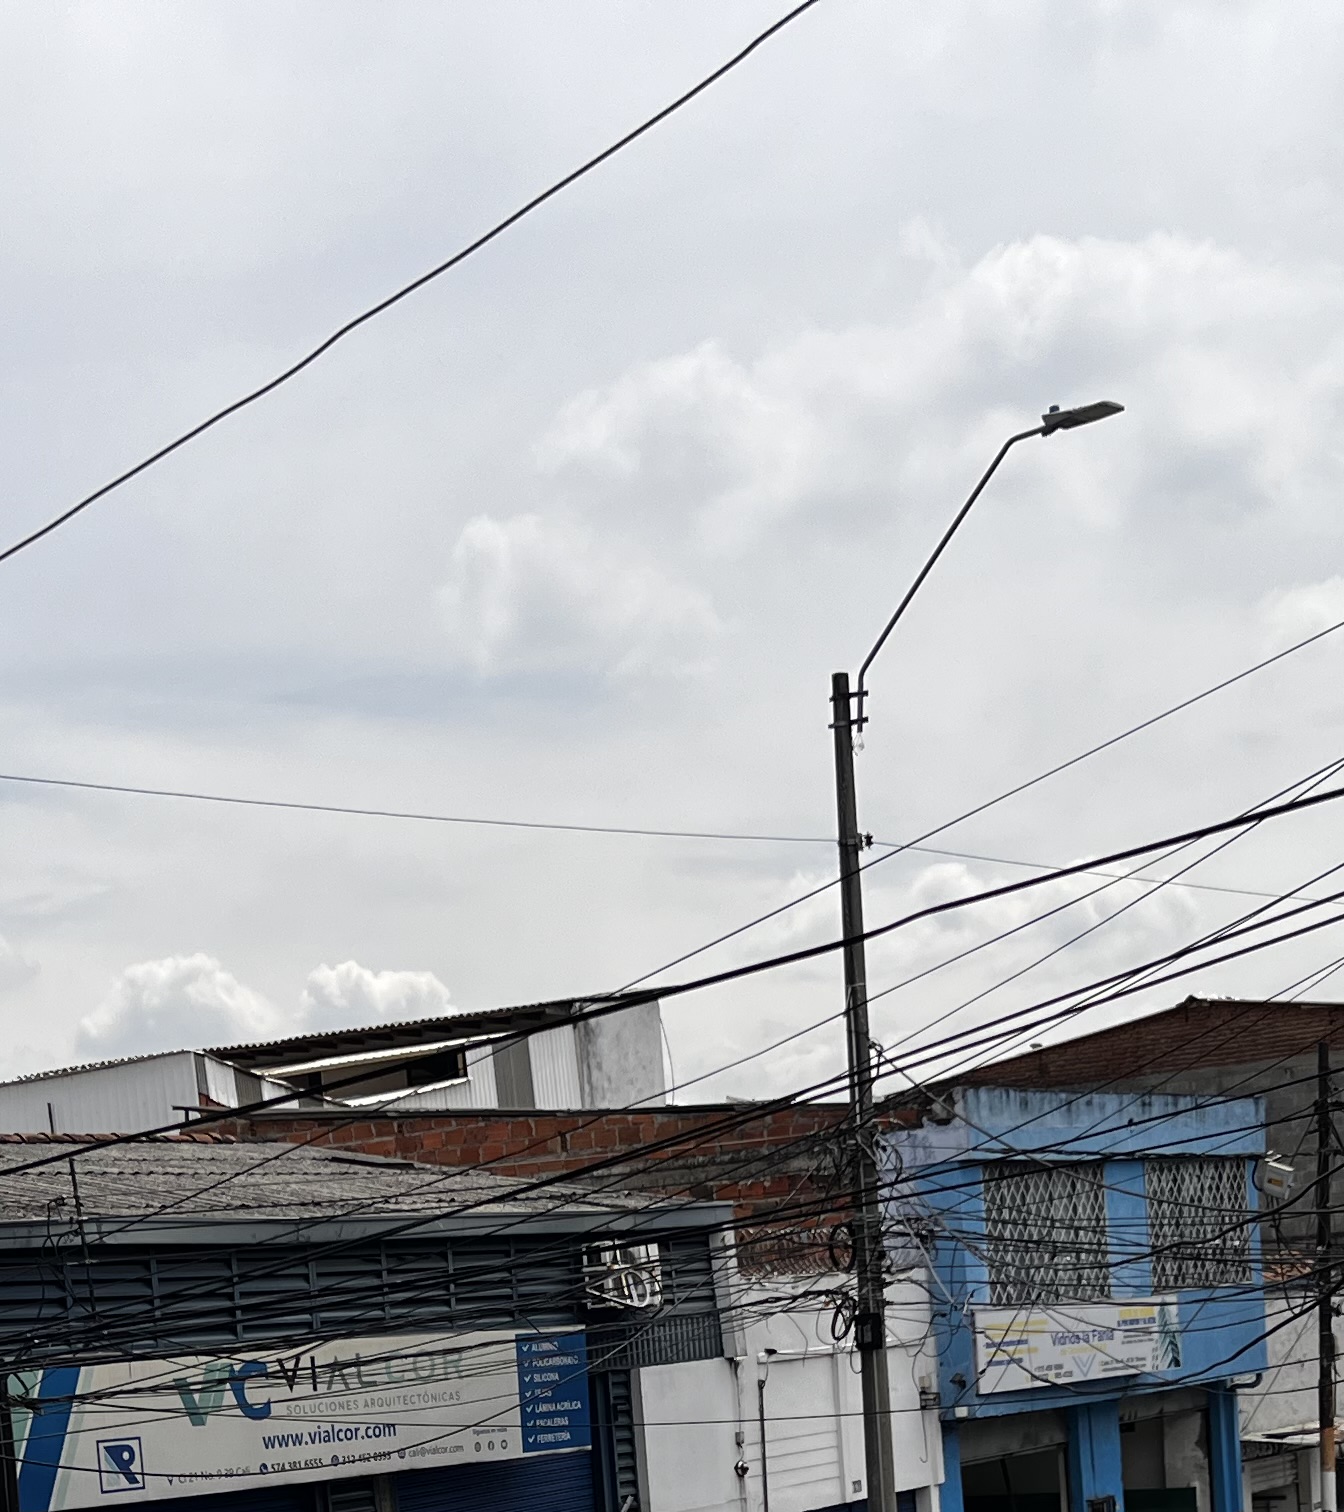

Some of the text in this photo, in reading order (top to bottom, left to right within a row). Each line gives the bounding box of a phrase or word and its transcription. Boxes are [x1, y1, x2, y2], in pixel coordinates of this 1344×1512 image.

[277, 1350, 464, 1393] VIALCOR
[286, 1390, 461, 1415] SOLUCIONES ARQUITECTÓNICAS
[262, 1424, 397, 1450] www.vialcor.com
